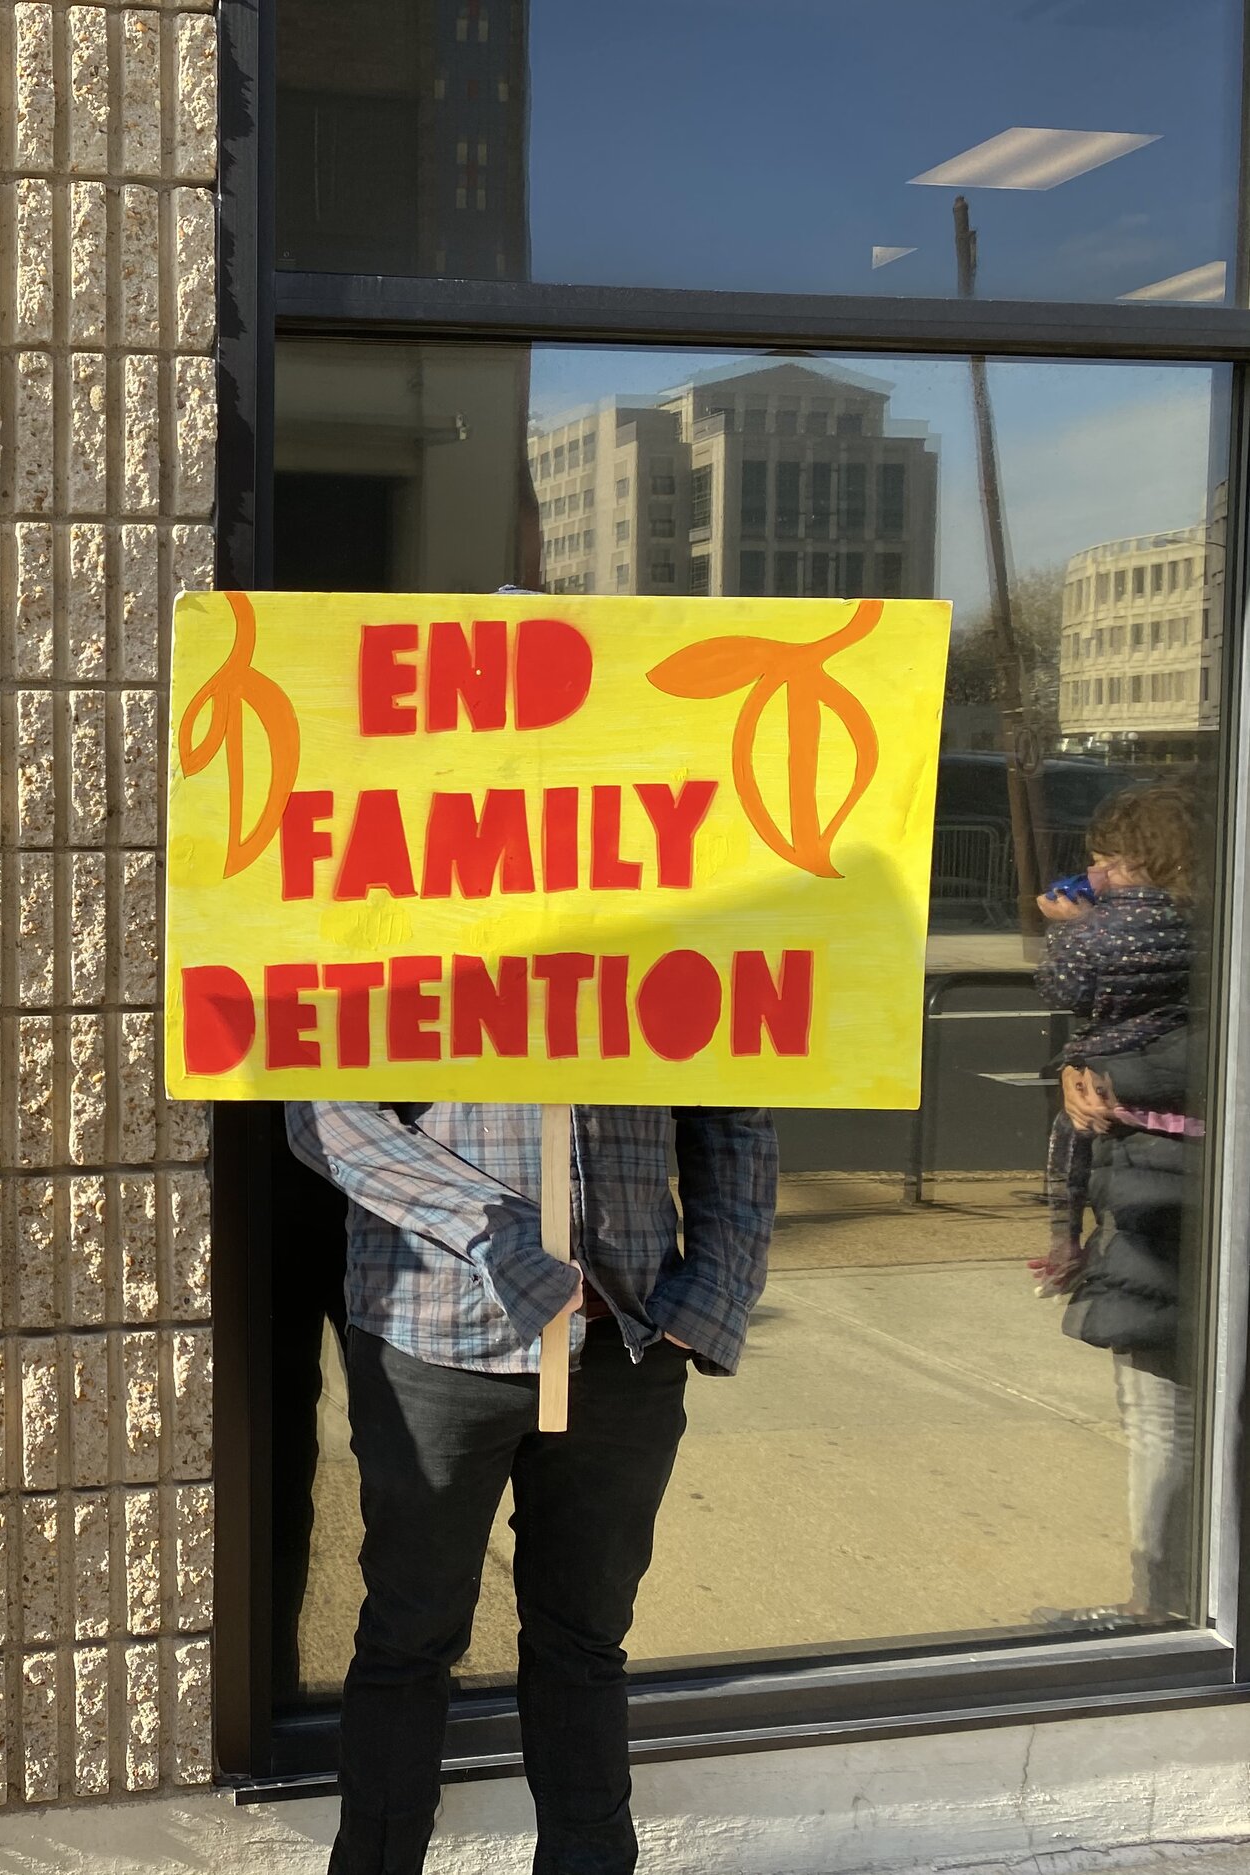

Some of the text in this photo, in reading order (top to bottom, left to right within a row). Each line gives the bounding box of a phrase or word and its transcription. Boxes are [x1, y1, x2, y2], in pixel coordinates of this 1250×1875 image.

[359, 619, 593, 736] END
[280, 780, 718, 902] FAMILY
[181, 949, 814, 1075] DETENTION
